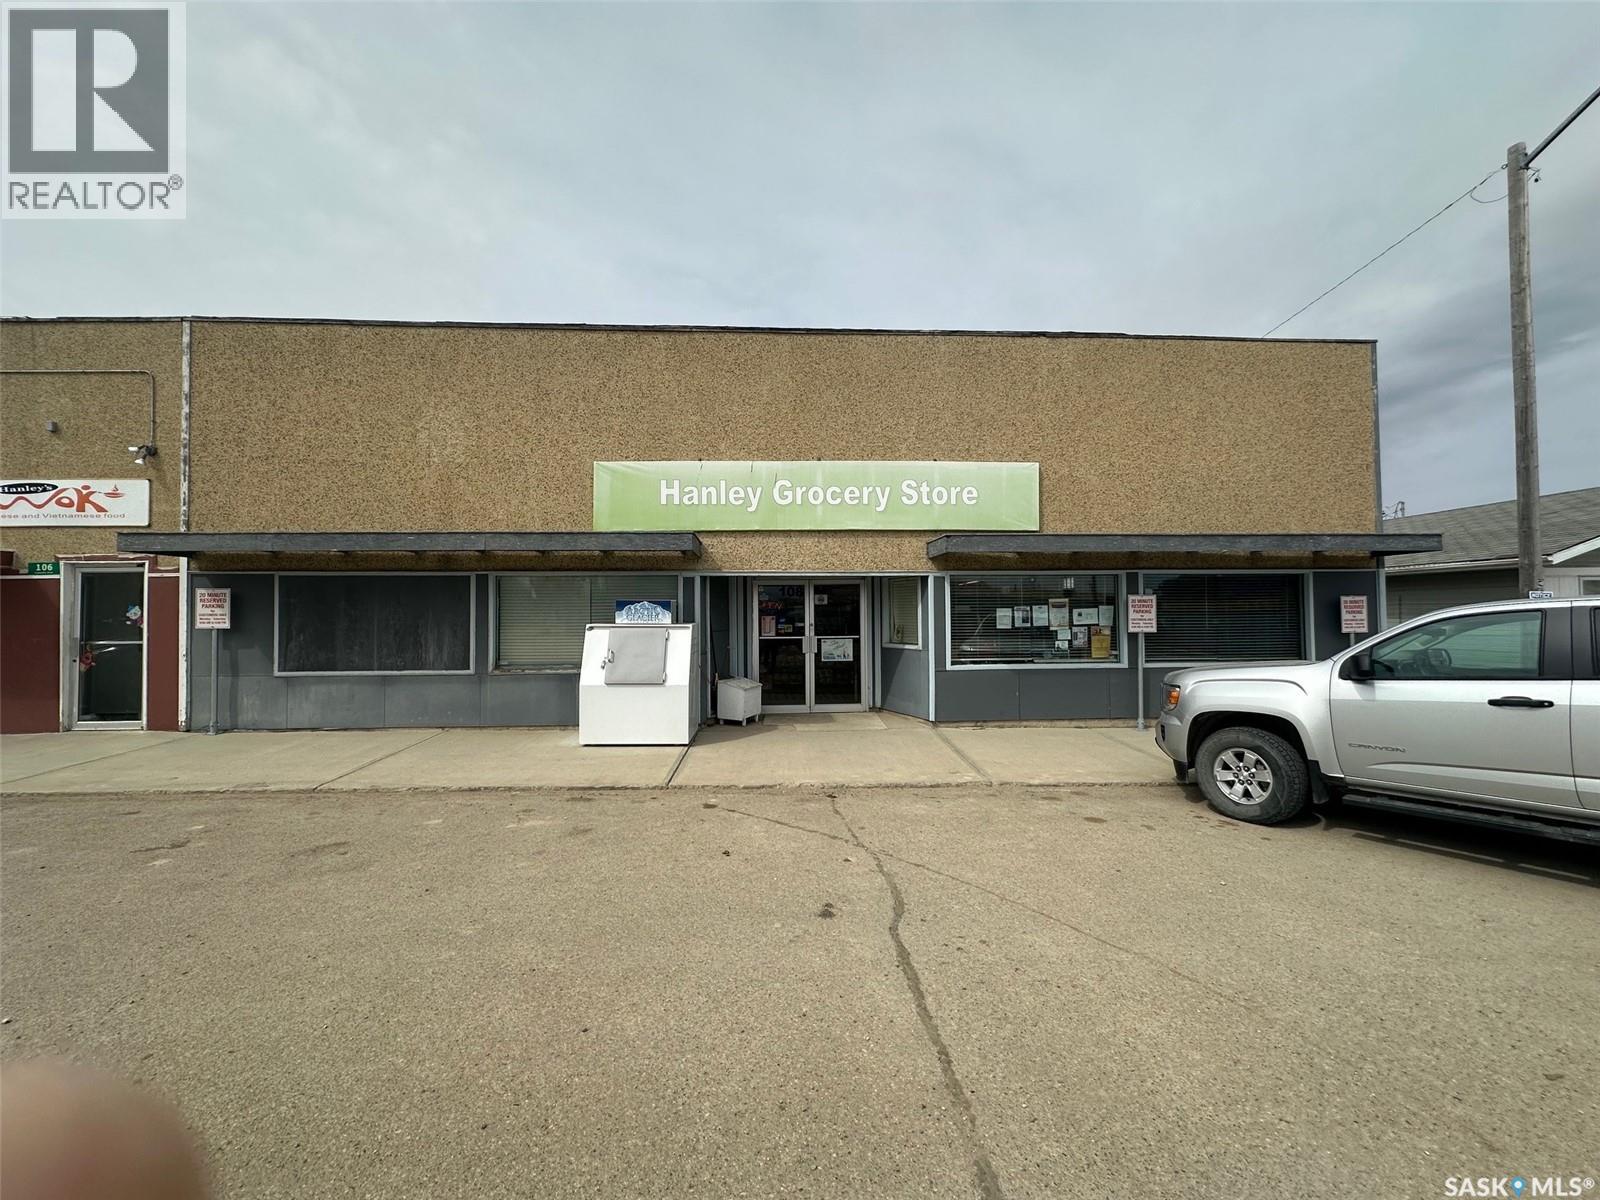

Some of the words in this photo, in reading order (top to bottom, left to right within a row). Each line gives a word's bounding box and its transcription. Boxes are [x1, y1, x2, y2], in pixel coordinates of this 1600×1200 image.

[0, 485, 53, 493] Hanley's
[659, 479, 762, 513] Hanley
[773, 478, 891, 513] Grocery
[900, 478, 979, 506] Store
[36, 563, 54, 571] 106
[1348, 743, 1406, 753] CANYON
